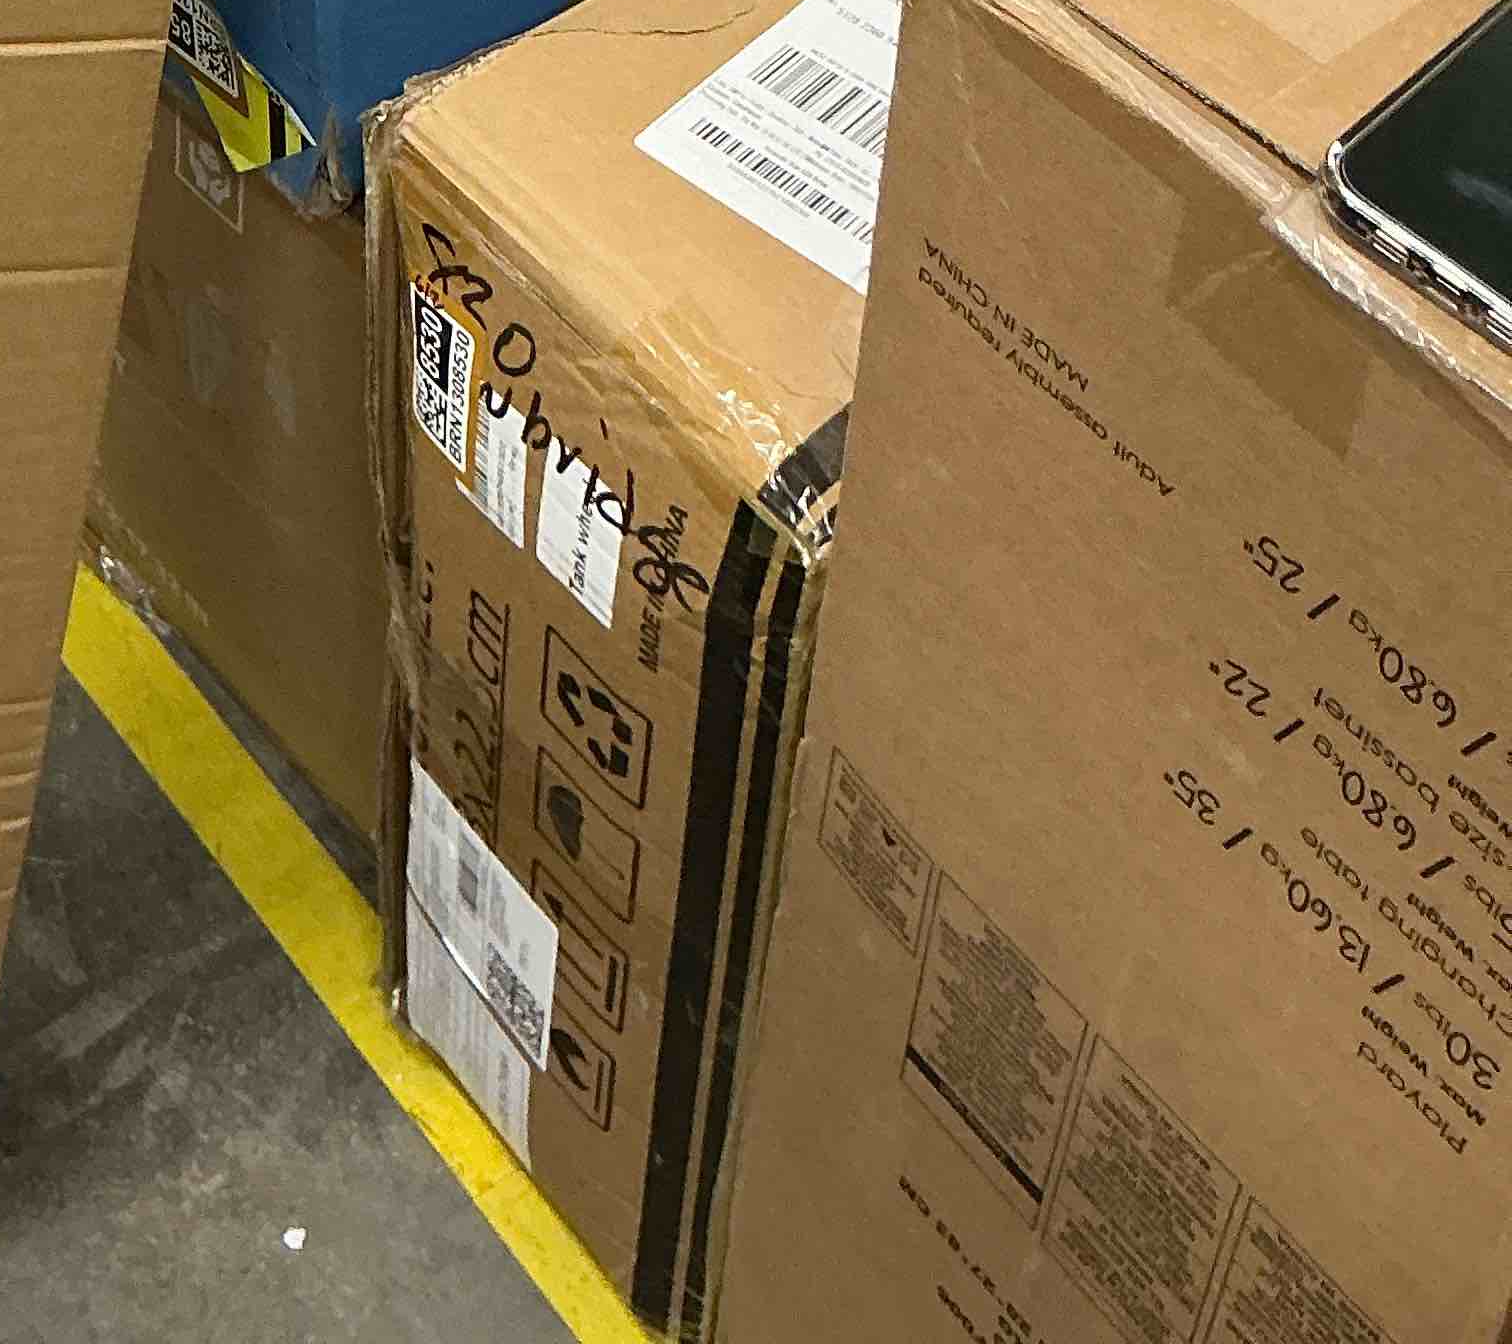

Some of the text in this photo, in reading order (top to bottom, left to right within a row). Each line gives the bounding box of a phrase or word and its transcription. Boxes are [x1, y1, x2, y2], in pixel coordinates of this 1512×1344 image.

[415, 306, 443, 381] 8530
[924, 237, 1090, 393] MADE IN CHINA
[448, 329, 472, 464] BRN1308530
[918, 266, 1177, 497] Adult assembly required
[568, 551, 588, 598] Tank
[636, 604, 666, 674] MADE
[1347, 608, 1458, 729] 6.80kg
[1311, 732, 1418, 851] 6.80kg
[1313, 687, 1440, 814] bassinet
[1259, 840, 1372, 975] 13.60kg
[1299, 825, 1370, 904] table
[1406, 891, 1475, 964] Weight
[1356, 1040, 1469, 1155] Playard
[1360, 1004, 1430, 1079] Weight
[1413, 990, 1502, 1091] 30lbs
